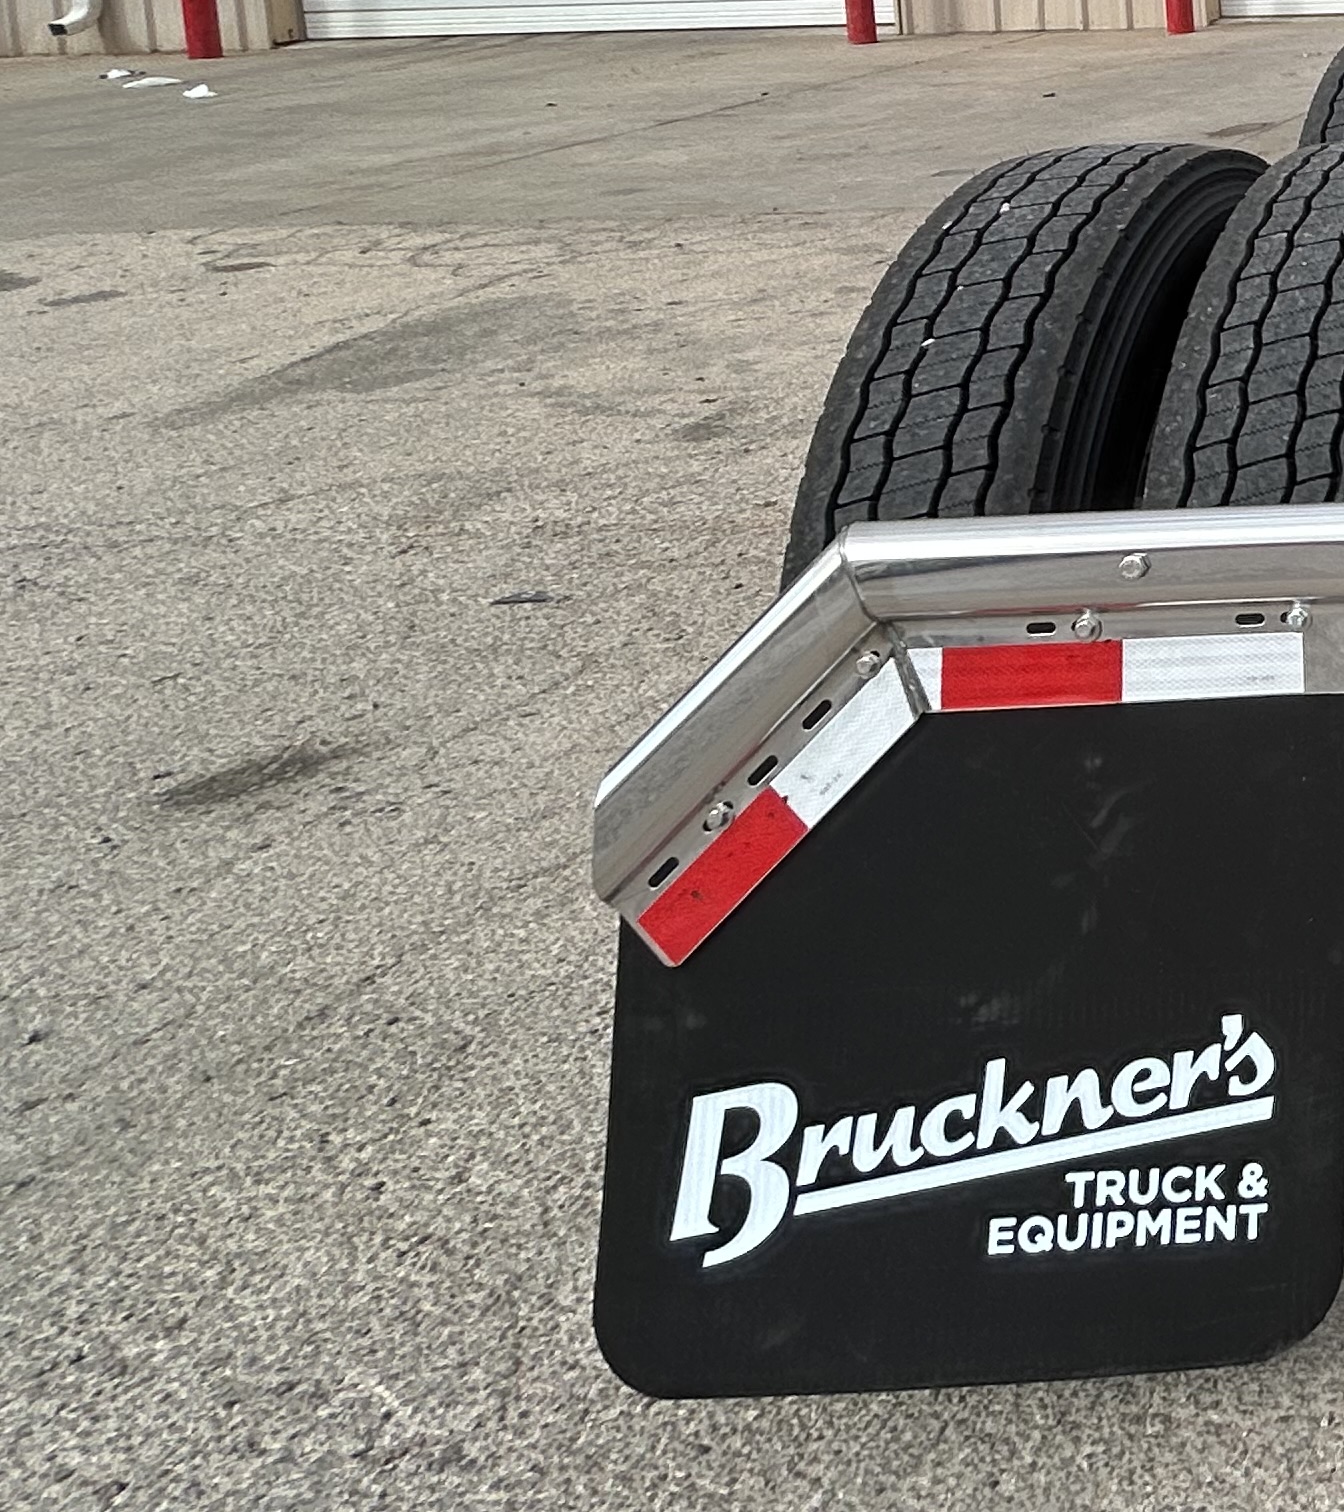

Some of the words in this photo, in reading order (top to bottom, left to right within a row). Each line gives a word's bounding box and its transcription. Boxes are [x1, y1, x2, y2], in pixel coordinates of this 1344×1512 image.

[669, 1013, 1275, 1268] Bruckner's
[1064, 1163, 1226, 1209] TRUCK
[1237, 1162, 1269, 1199] &
[987, 1202, 1269, 1256] EQUIPMENT
